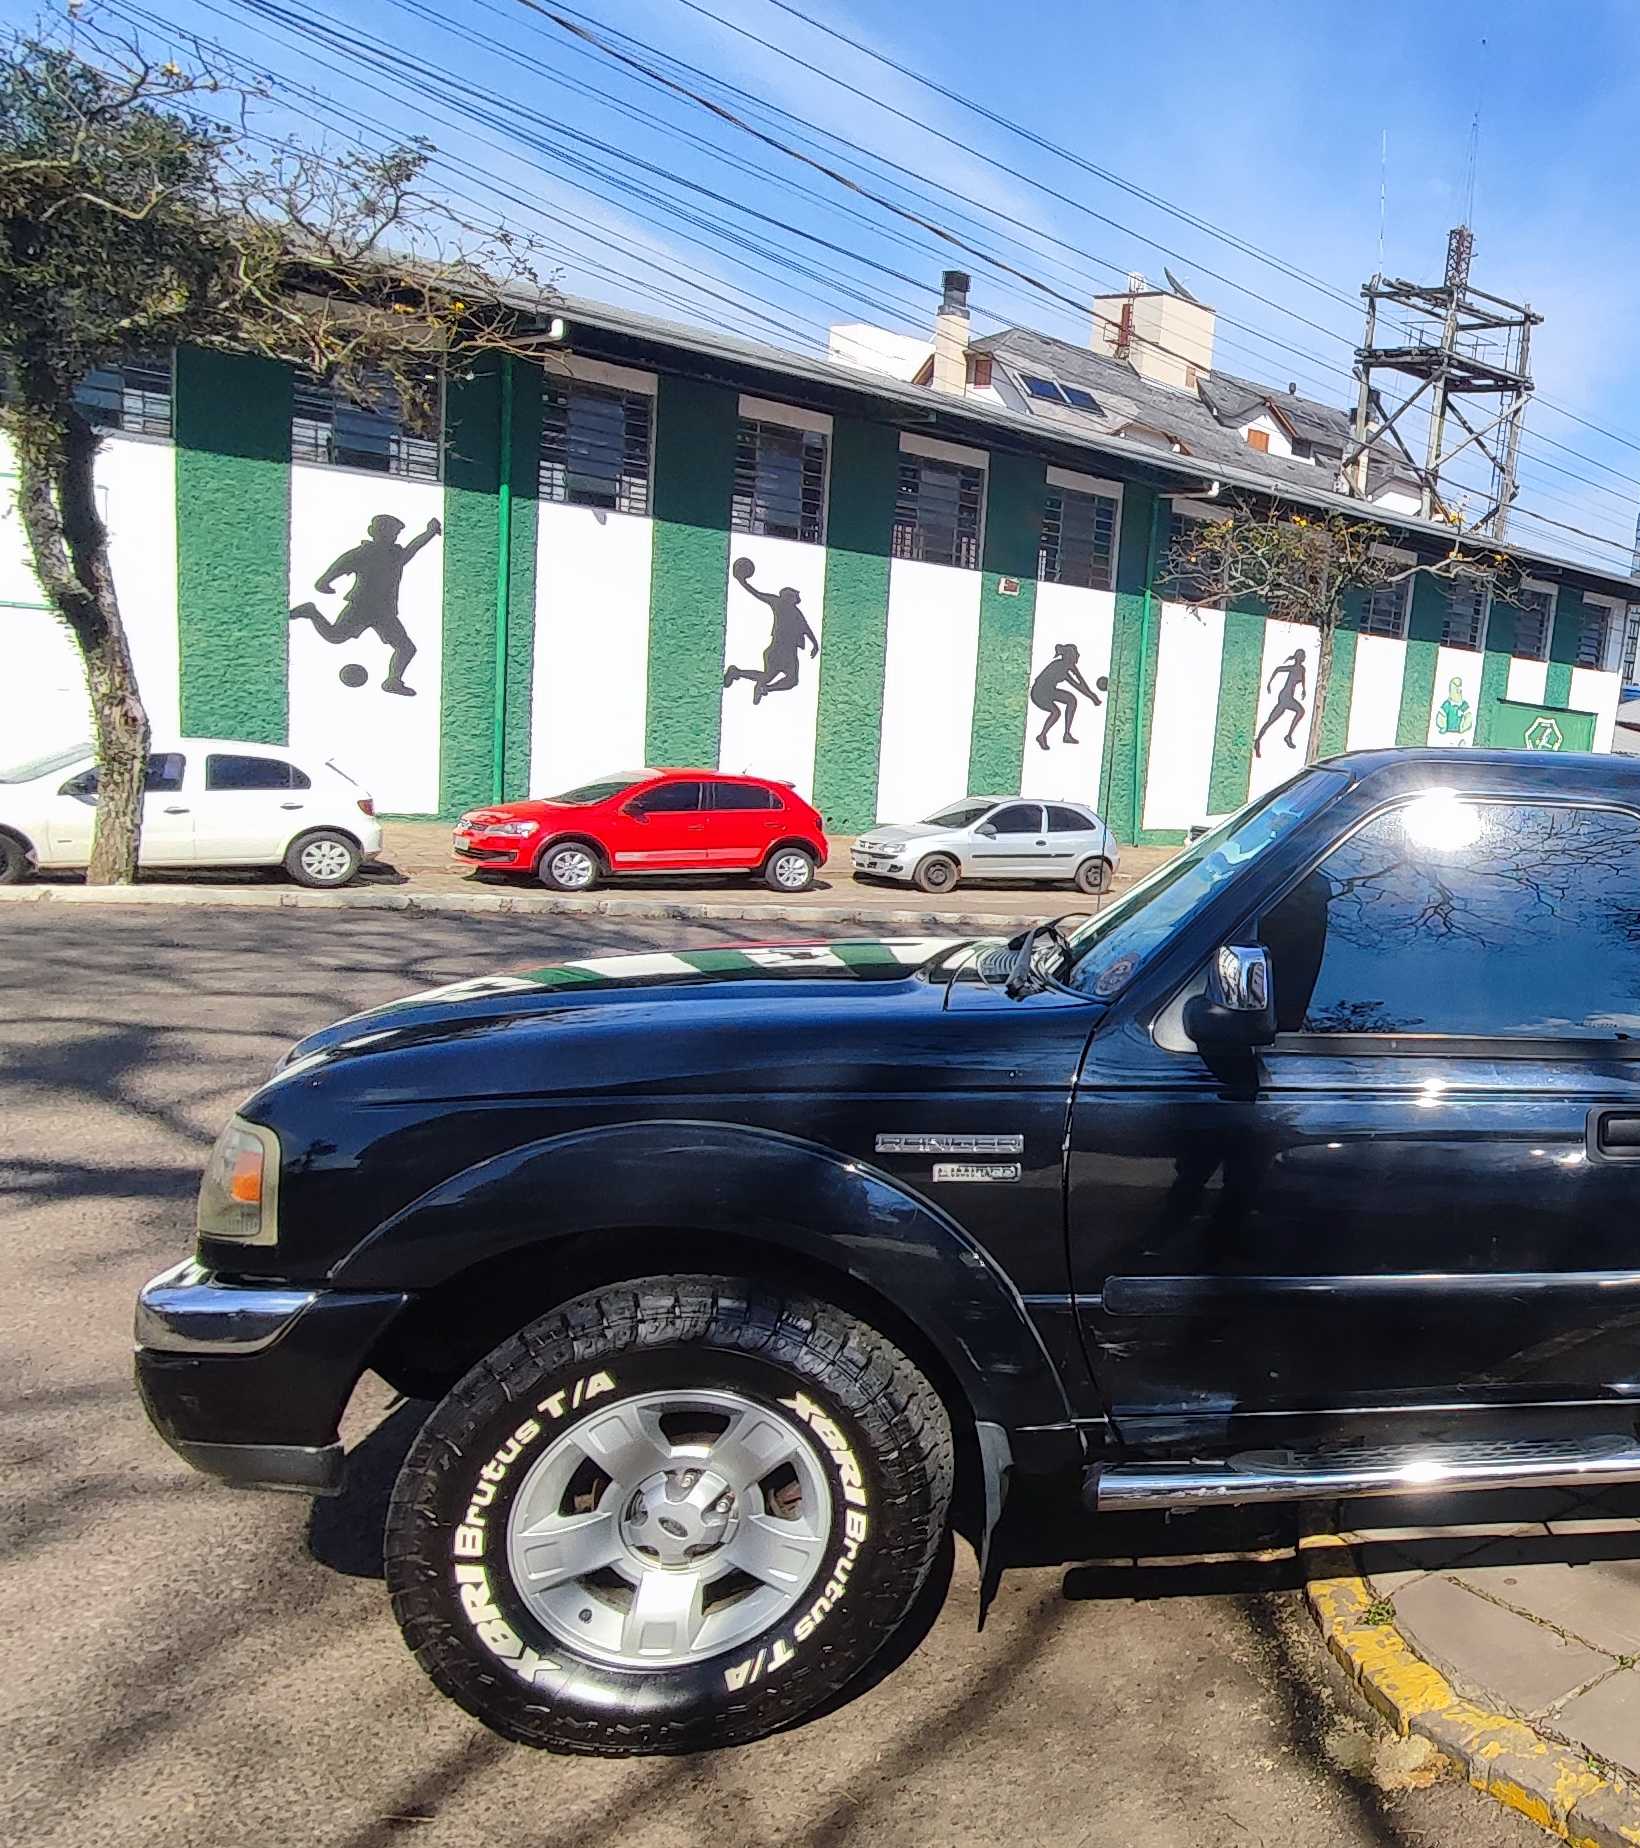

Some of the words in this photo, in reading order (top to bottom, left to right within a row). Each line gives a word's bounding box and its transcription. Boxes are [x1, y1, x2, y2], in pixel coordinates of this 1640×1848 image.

[454, 1422, 541, 1558] Brutus
[537, 1371, 617, 1417] T/A
[794, 1510, 868, 1643] Brutus
[724, 1649, 796, 1692] T/A
